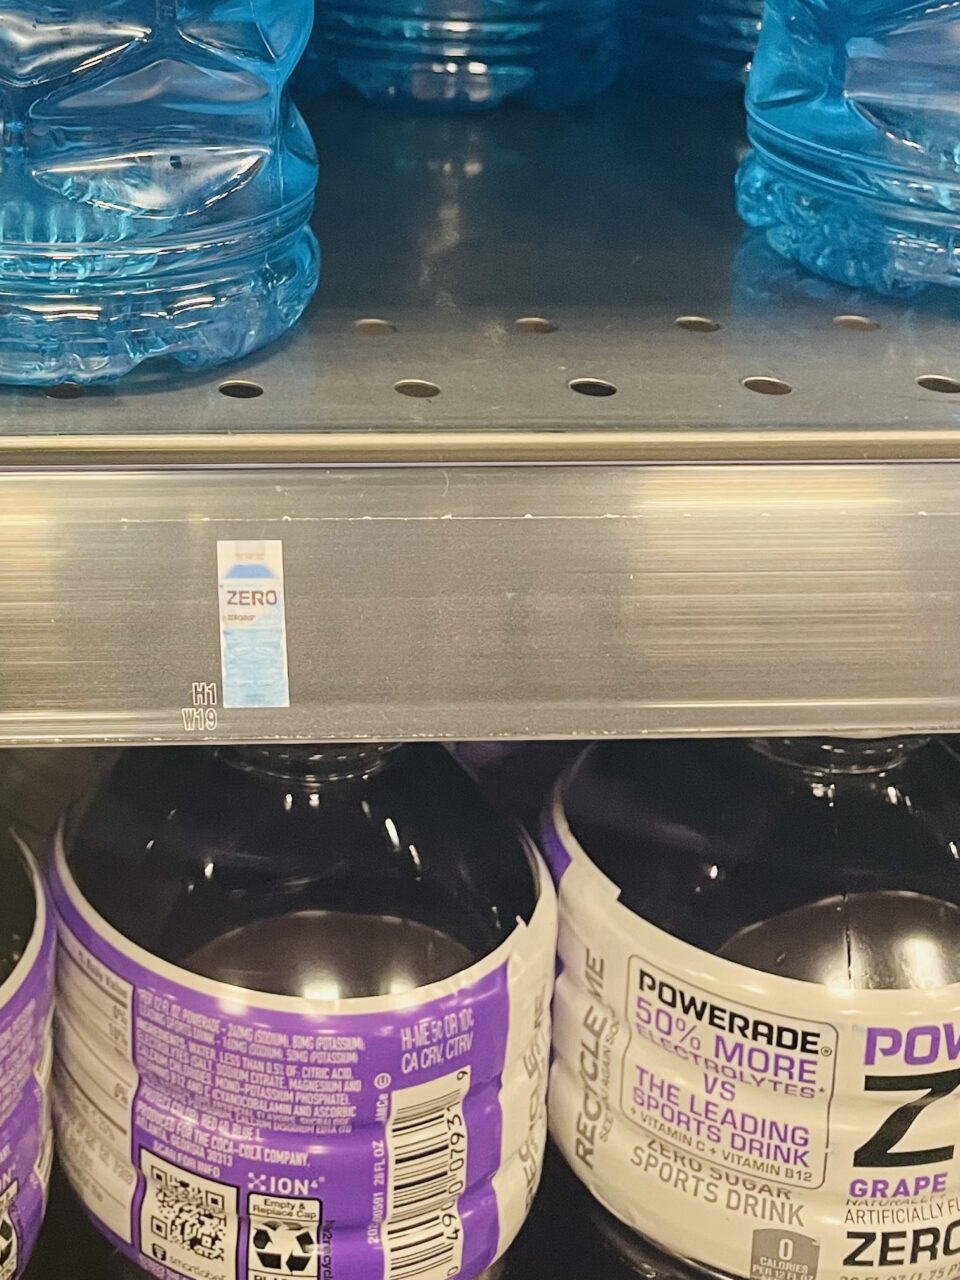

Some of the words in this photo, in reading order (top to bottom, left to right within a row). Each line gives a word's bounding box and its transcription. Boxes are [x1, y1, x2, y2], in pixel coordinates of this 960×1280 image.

[227, 590, 278, 606] ZERO
[636, 996, 701, 1051] 50%
[714, 1035, 818, 1084] MORE
[703, 1072, 736, 1102] VS
[635, 1065, 681, 1107] THE
[689, 1093, 810, 1148] LEADING
[632, 1086, 722, 1144] SPORTS
[731, 1131, 810, 1168] DRINK
[641, 1110, 695, 1149] VITAMIN
[721, 1145, 781, 1177] VITAMIN
[785, 1168, 813, 1183] B12
[647, 1139, 702, 1172] ZERO
[709, 1166, 792, 1200] SUGAR
[631, 1147, 719, 1205] SPORTS
[726, 1188, 805, 1227] DRINK
[849, 1172, 948, 1198] GRAPE
[252, 1203, 294, 1217] Replace
[297, 1209, 316, 1221] Cap
[264, 1198, 296, 1211] Empty
[845, 1201, 948, 1225] ARTIFICIALLY
[779, 1238, 794, 1261] 0
[843, 1219, 960, 1267] ZERO
[759, 1256, 809, 1272] CALORIES
